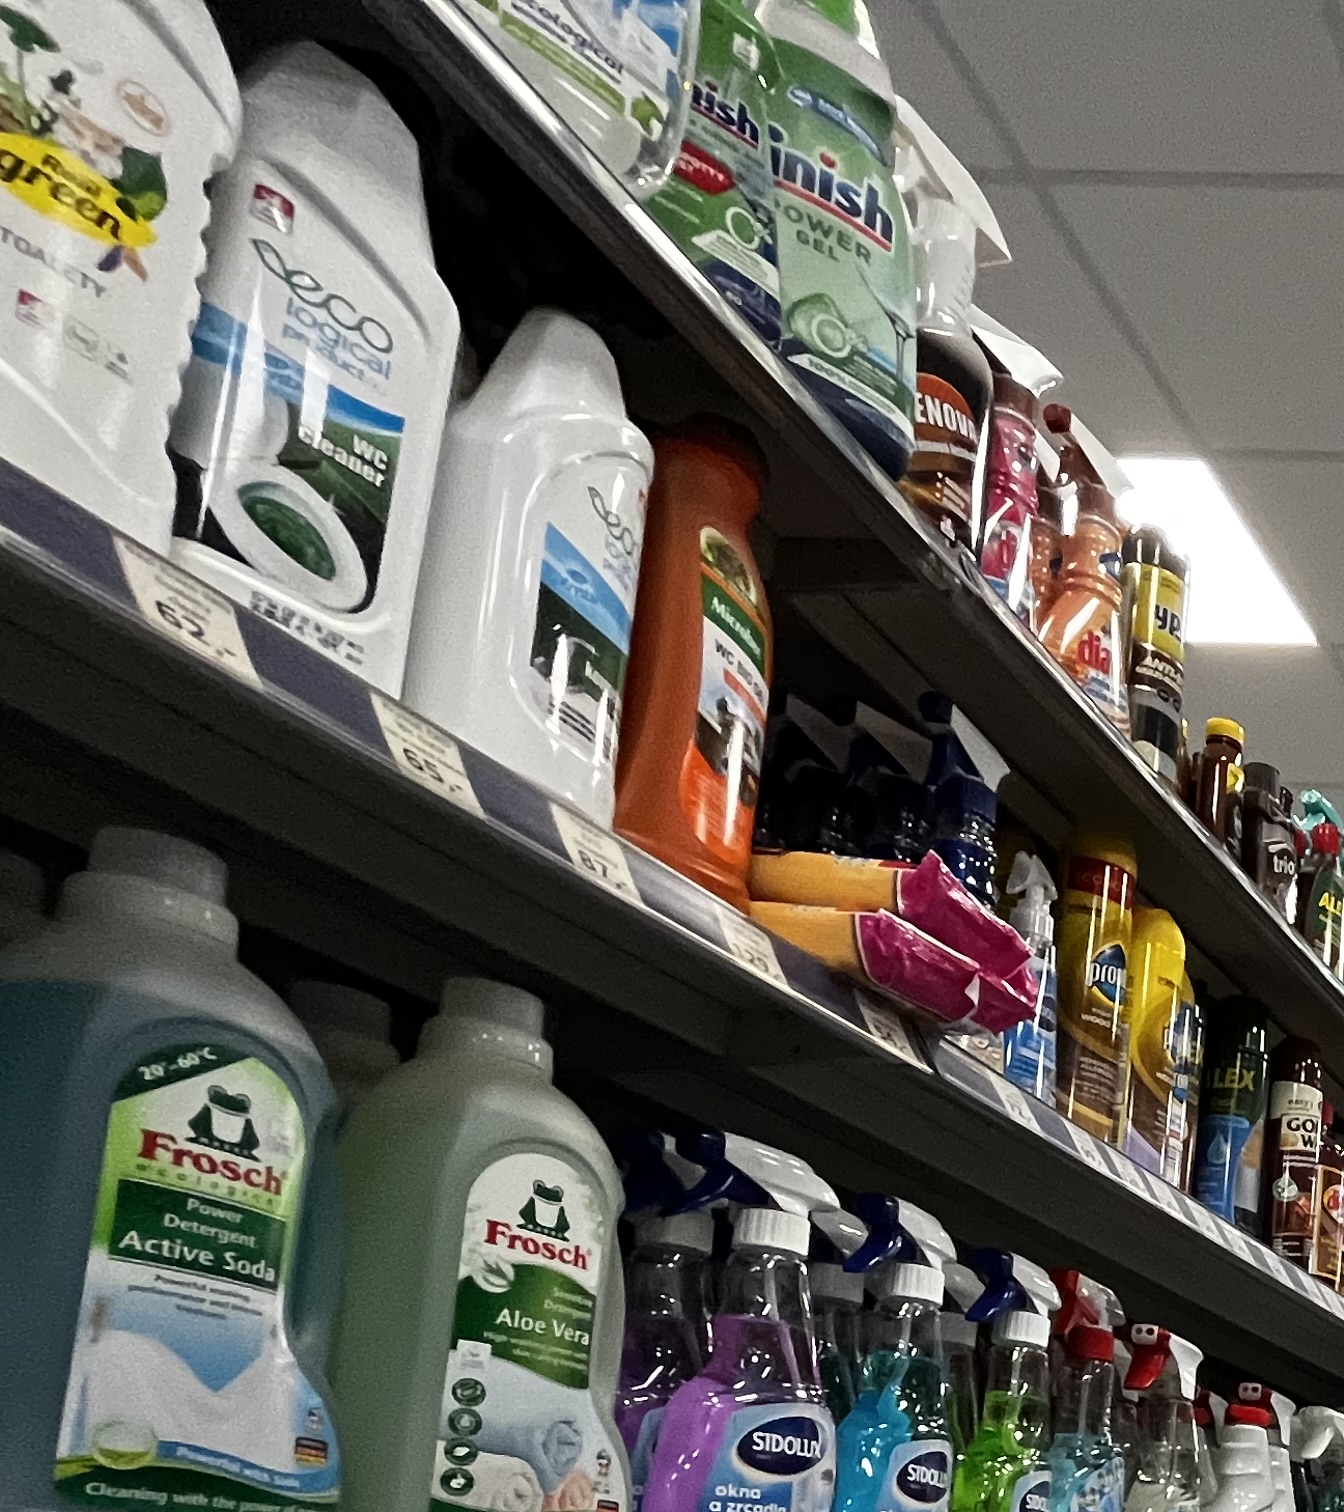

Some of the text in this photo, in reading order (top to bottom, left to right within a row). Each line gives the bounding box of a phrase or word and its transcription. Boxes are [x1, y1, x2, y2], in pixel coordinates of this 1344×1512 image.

[768, 122, 893, 247] inish
[786, 205, 873, 266] OWER
[795, 227, 841, 262] GEL
[284, 297, 392, 380] logical
[352, 434, 389, 471] WC
[1207, 1065, 1256, 1092] LEX
[1286, 1116, 1317, 1133] GO
[137, 1127, 283, 1197] Frosch
[186, 1197, 243, 1224] Power
[163, 1212, 256, 1250] Detergent
[483, 1218, 589, 1270] Frosch
[117, 1229, 276, 1283] Active Soda
[494, 1308, 590, 1346] Aloe Vera
[752, 1431, 822, 1459] SIDOLUX
[715, 1484, 762, 1500] okna
[906, 1463, 949, 1488] SIDOLU
[708, 1501, 723, 1512] a
